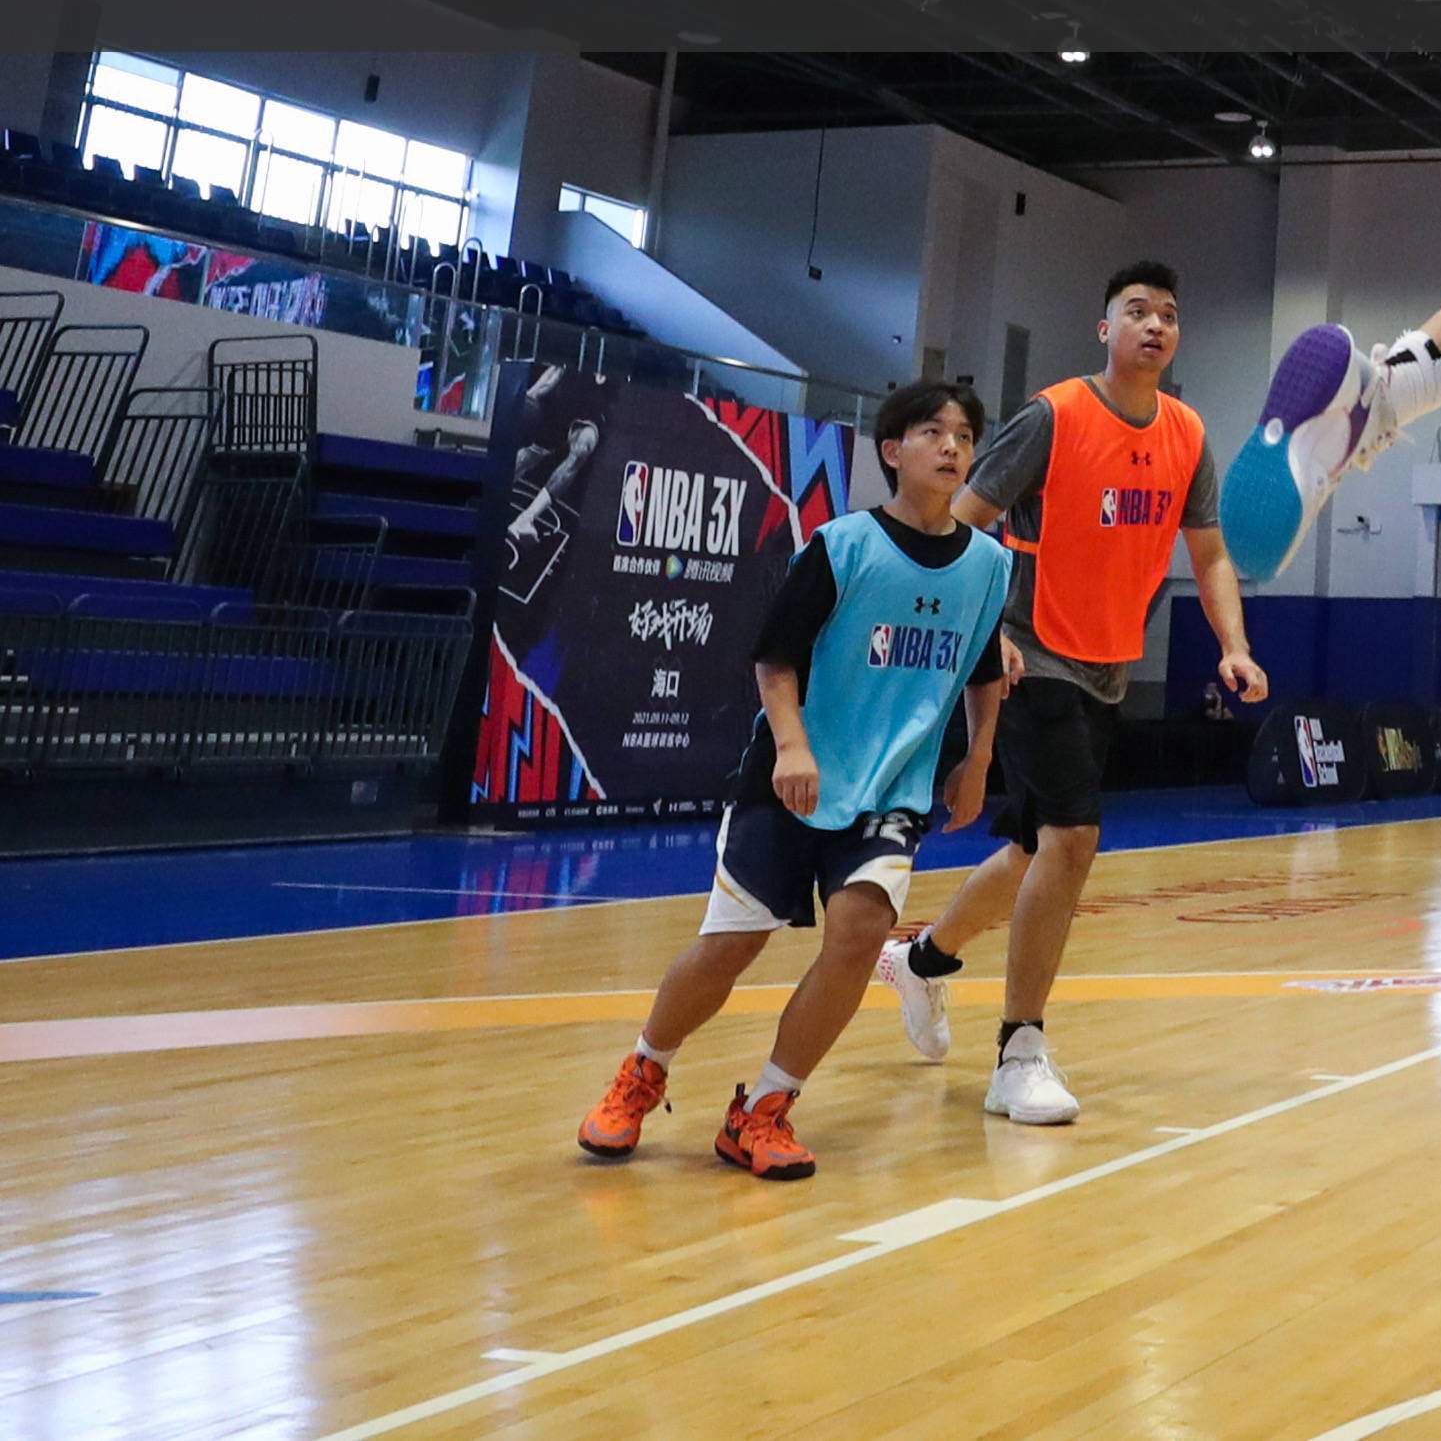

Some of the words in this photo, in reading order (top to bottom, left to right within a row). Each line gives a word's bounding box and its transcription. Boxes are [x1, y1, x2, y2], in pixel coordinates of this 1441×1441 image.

[643, 466, 705, 552] NBA
[706, 475, 748, 556] 3X
[1119, 489, 1152, 526] NBA
[888, 625, 935, 670] NBA
[935, 629, 963, 674] 3X
[651, 668, 681, 698] 海口
